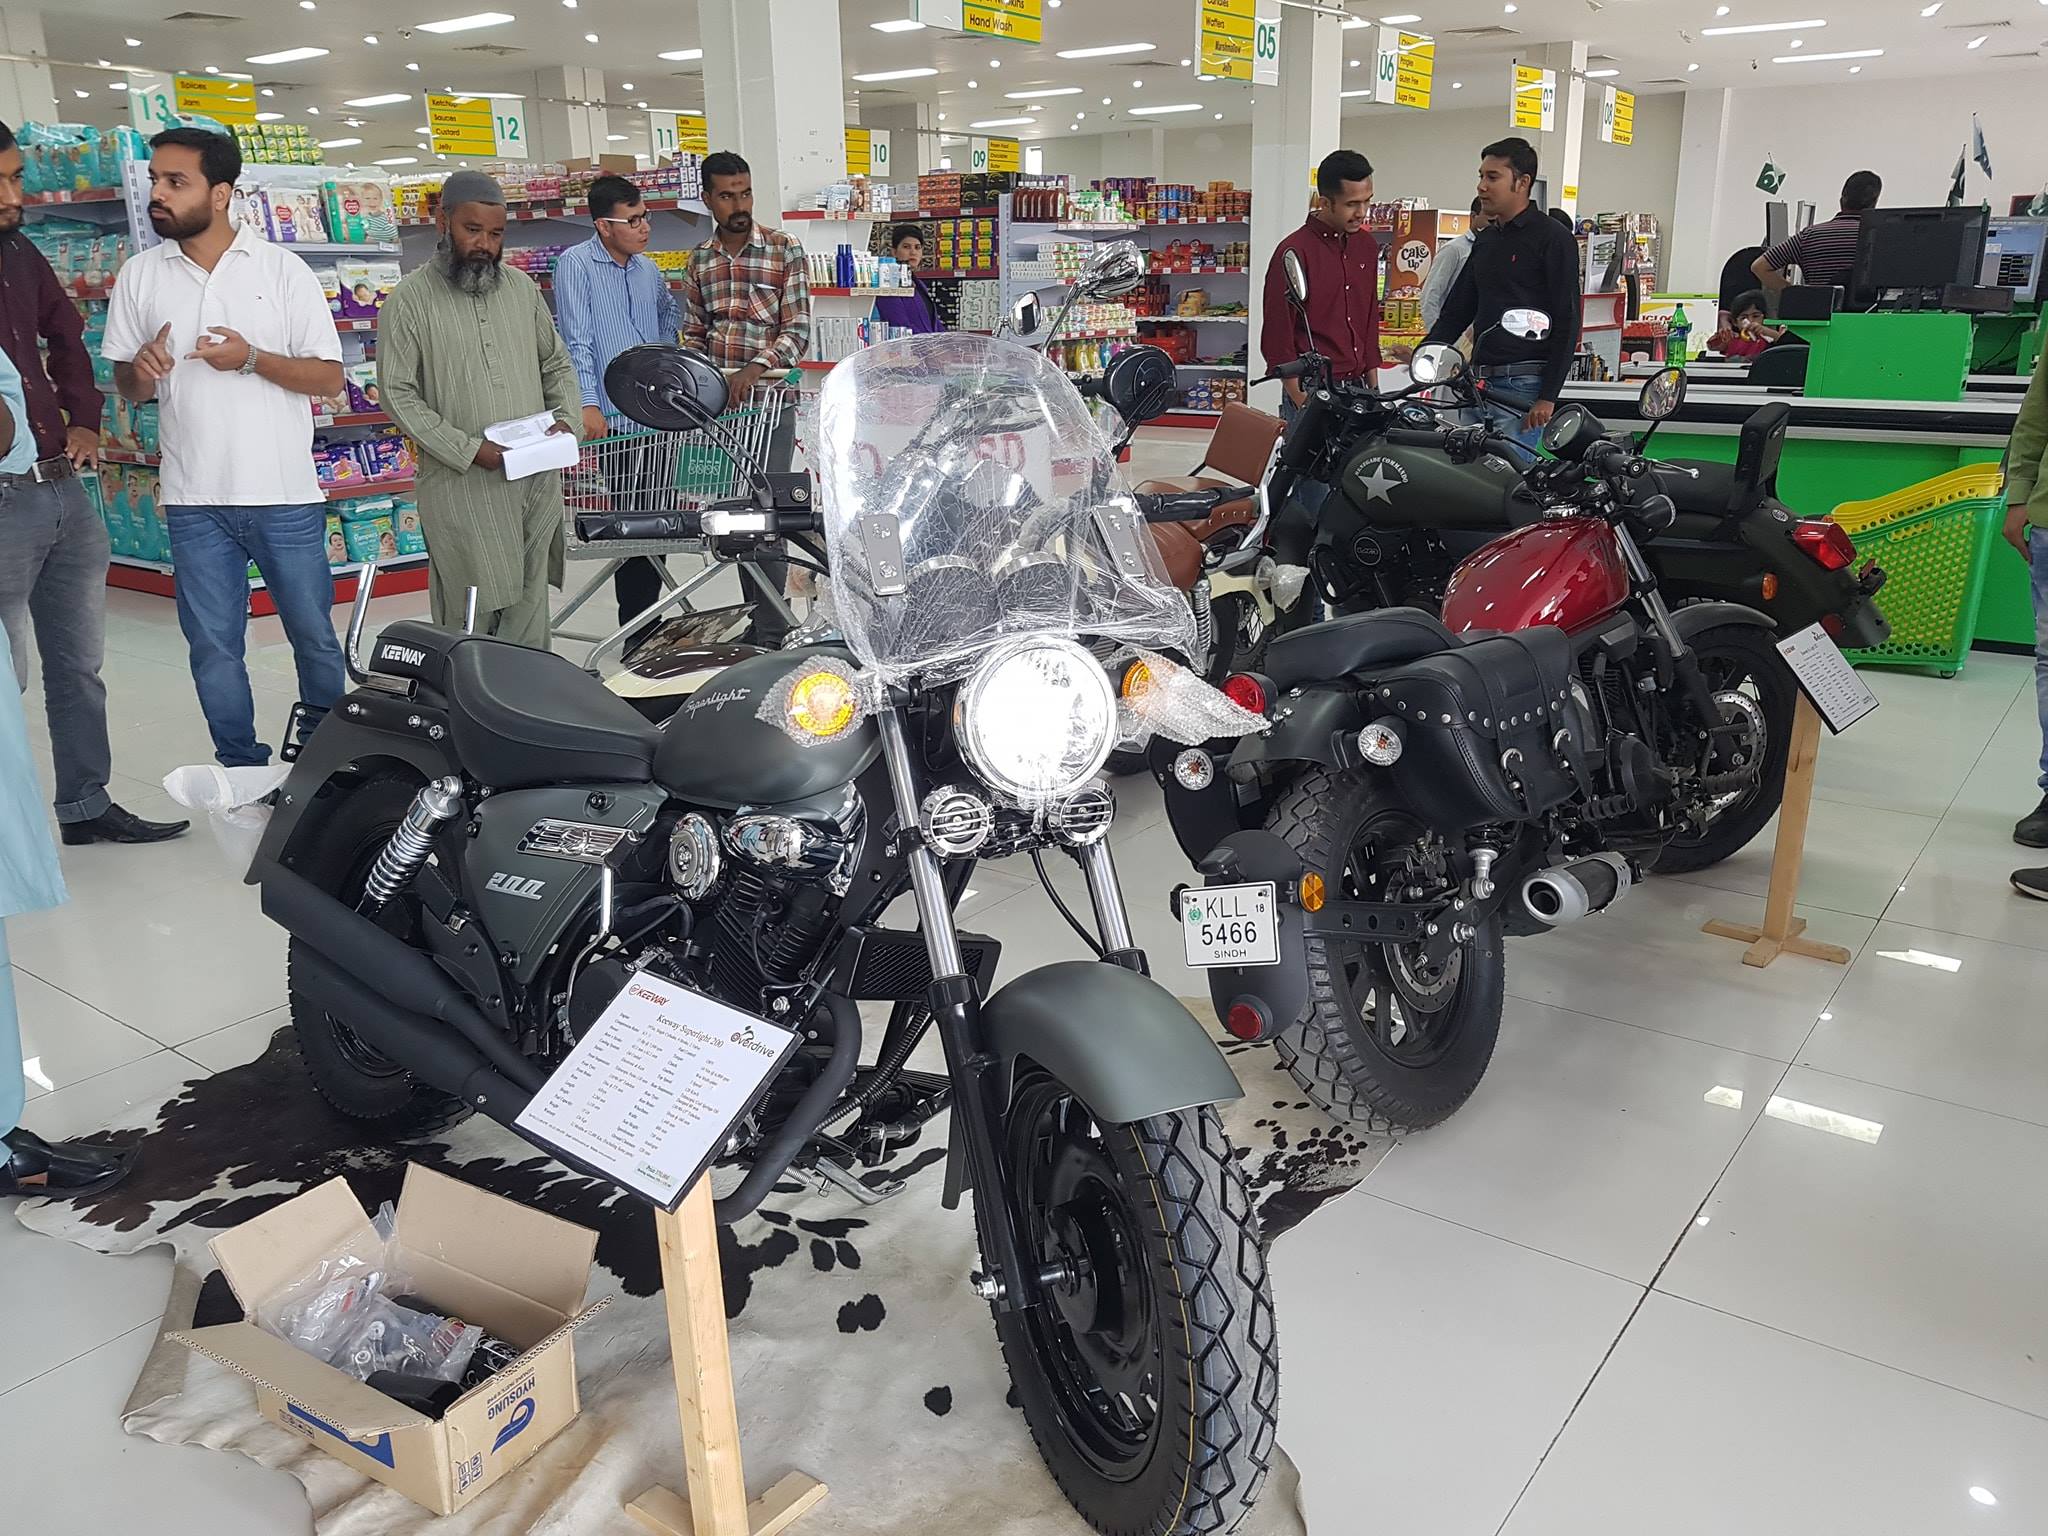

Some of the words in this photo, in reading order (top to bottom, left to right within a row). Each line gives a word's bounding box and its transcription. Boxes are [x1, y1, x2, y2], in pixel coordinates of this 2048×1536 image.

[969, 13, 991, 28] Hand
[993, 16, 1013, 32] Wash
[1257, 24, 1276, 60] 05
[1379, 50, 1395, 82] 06
[141, 93, 169, 122] 13
[1542, 87, 1553, 113] 07
[434, 114, 457, 122] Sauces
[497, 116, 520, 141] 12
[436, 128, 460, 136] Custard
[657, 128, 674, 150] 11
[873, 144, 887, 163] 10
[973, 150, 986, 168] 09
[1401, 244, 1429, 260] Cake
[381, 644, 426, 666] KEEWAY
[485, 872, 546, 900] 200
[1206, 895, 1247, 919] KLL
[1255, 903, 1265, 913] 18
[1201, 921, 1257, 946] 5466
[1214, 949, 1247, 959] SINDH
[637, 988, 670, 1006] KEEWAY
[656, 1013, 681, 1030] Keeway
[681, 1024, 712, 1045] Superlight
[709, 1036, 724, 1048] 200
[488, 1376, 535, 1420] HYOSUNG
